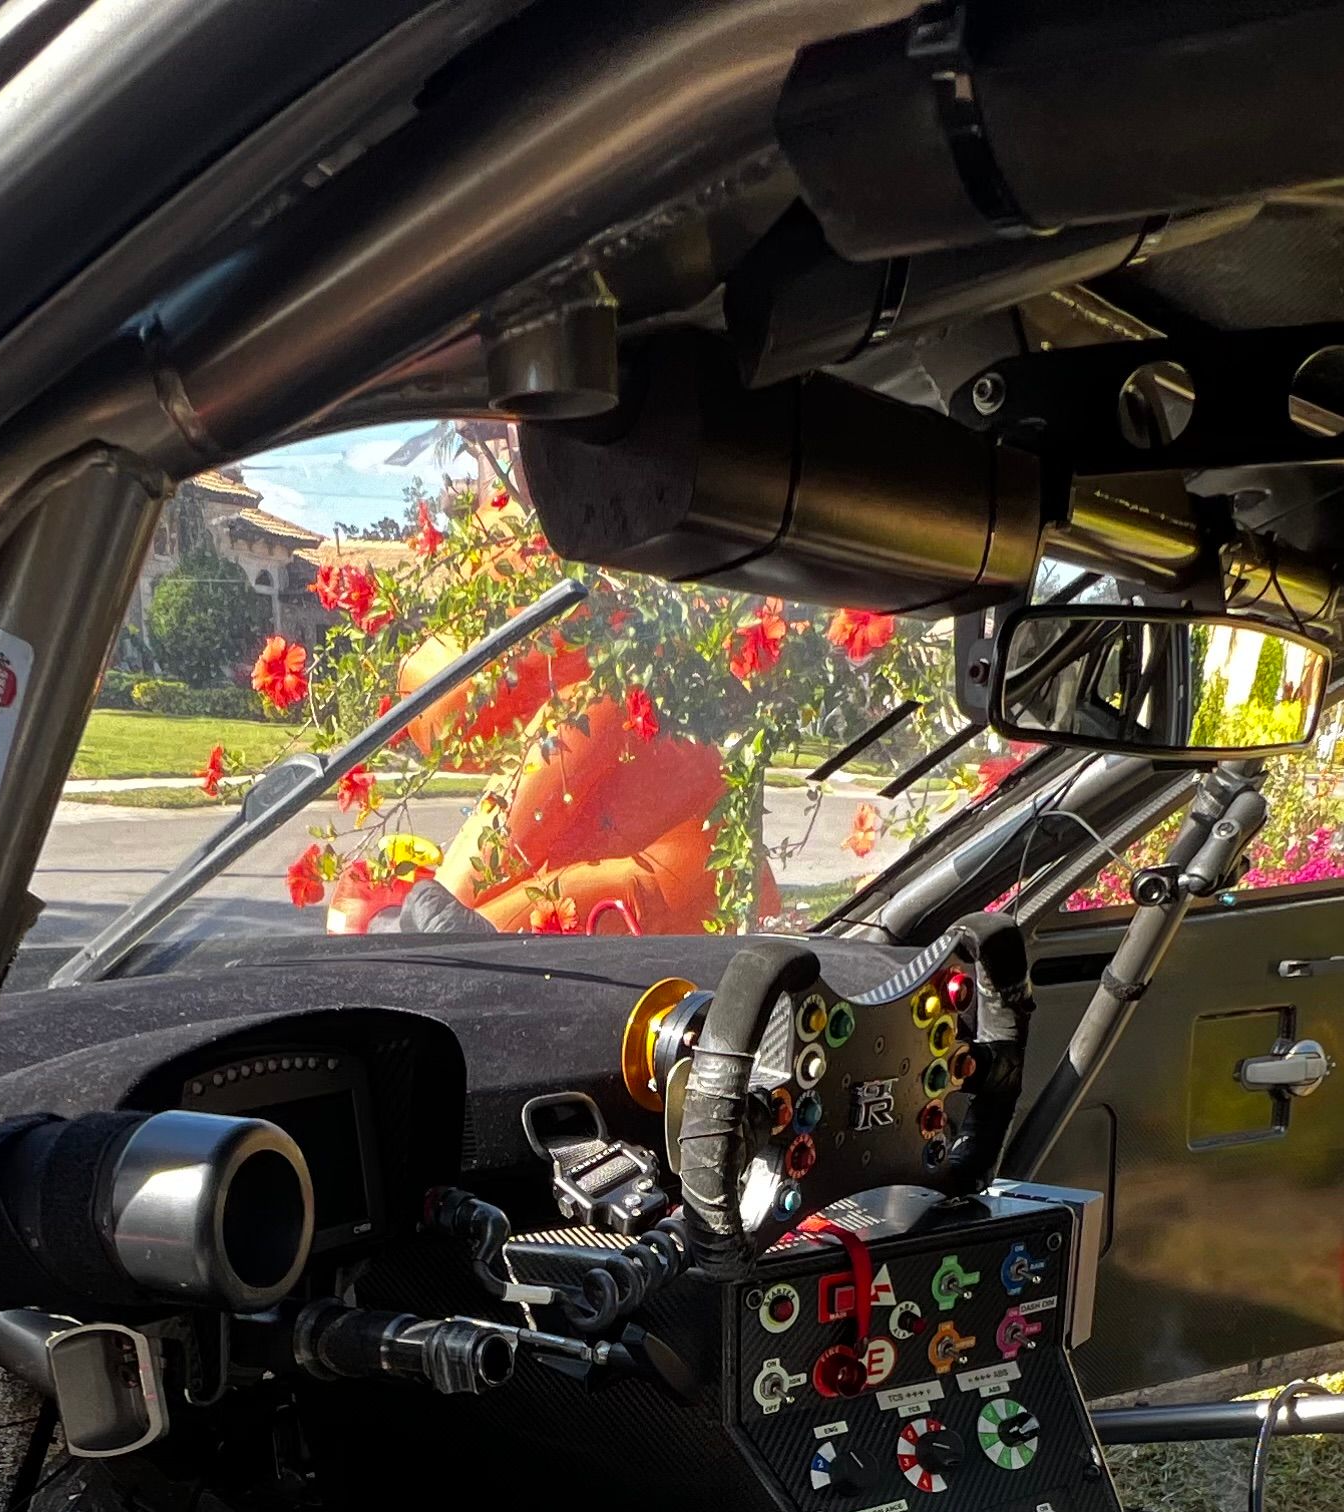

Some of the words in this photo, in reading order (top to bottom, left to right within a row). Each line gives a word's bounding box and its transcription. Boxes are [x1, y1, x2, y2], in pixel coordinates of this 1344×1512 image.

[764, 1288, 795, 1307] STARTER
[1021, 1303, 1040, 1312] DASH
[822, 1347, 840, 1361] FIRE
[868, 1348, 885, 1376] E
[888, 1392, 904, 1402] TCS
[765, 1404, 778, 1412] OFF
[824, 1426, 838, 1434] ENG
[818, 1459, 824, 1468] 2
